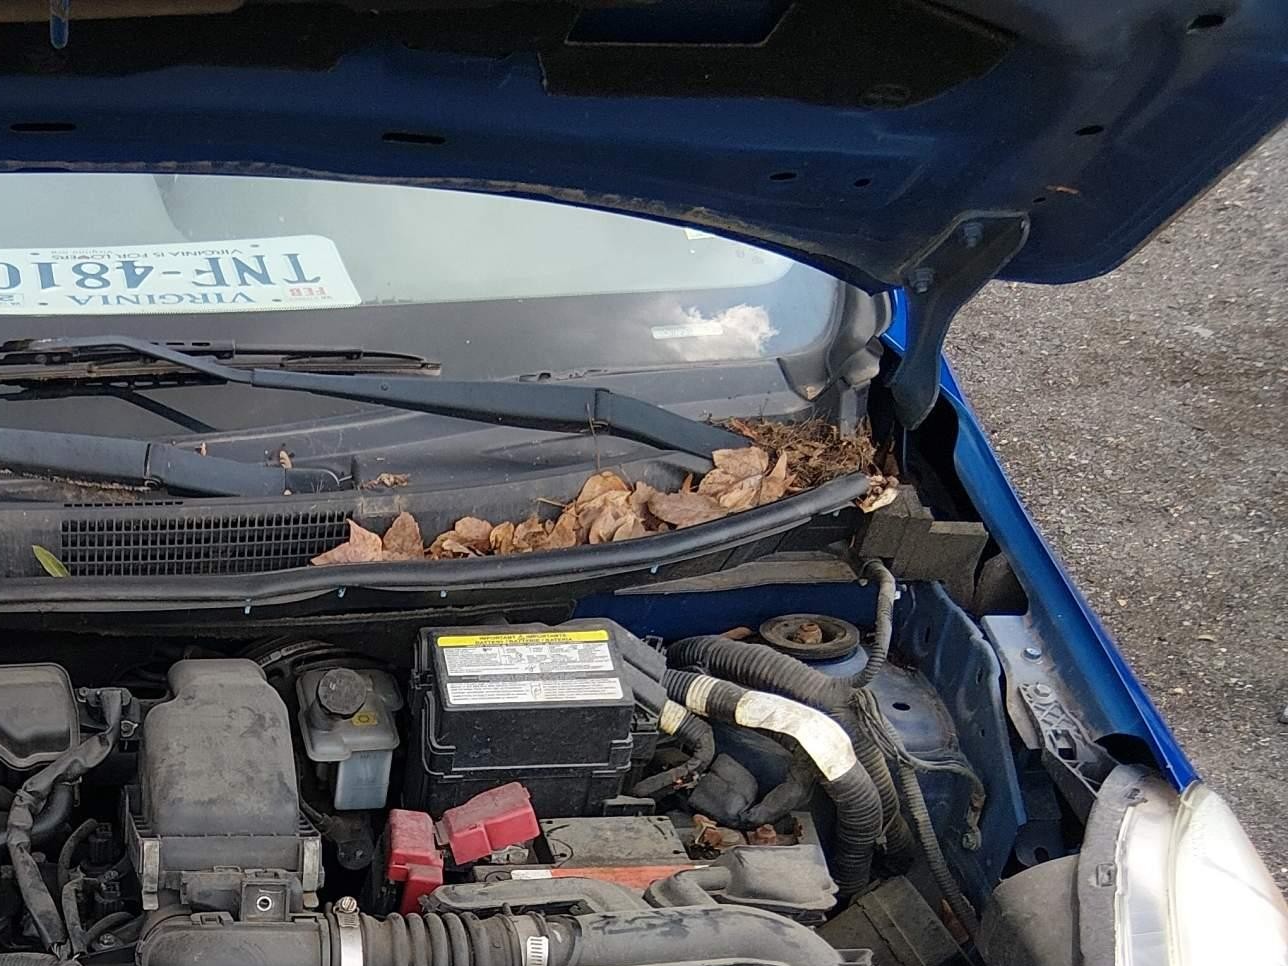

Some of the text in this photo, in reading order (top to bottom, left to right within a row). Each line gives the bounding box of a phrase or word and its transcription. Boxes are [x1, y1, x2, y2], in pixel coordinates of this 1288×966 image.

[116, 251, 148, 259] FOR
[168, 249, 243, 258] VIRGINIA
[289, 286, 327, 298] FEB
[67, 291, 255, 307] VIRGINIA
